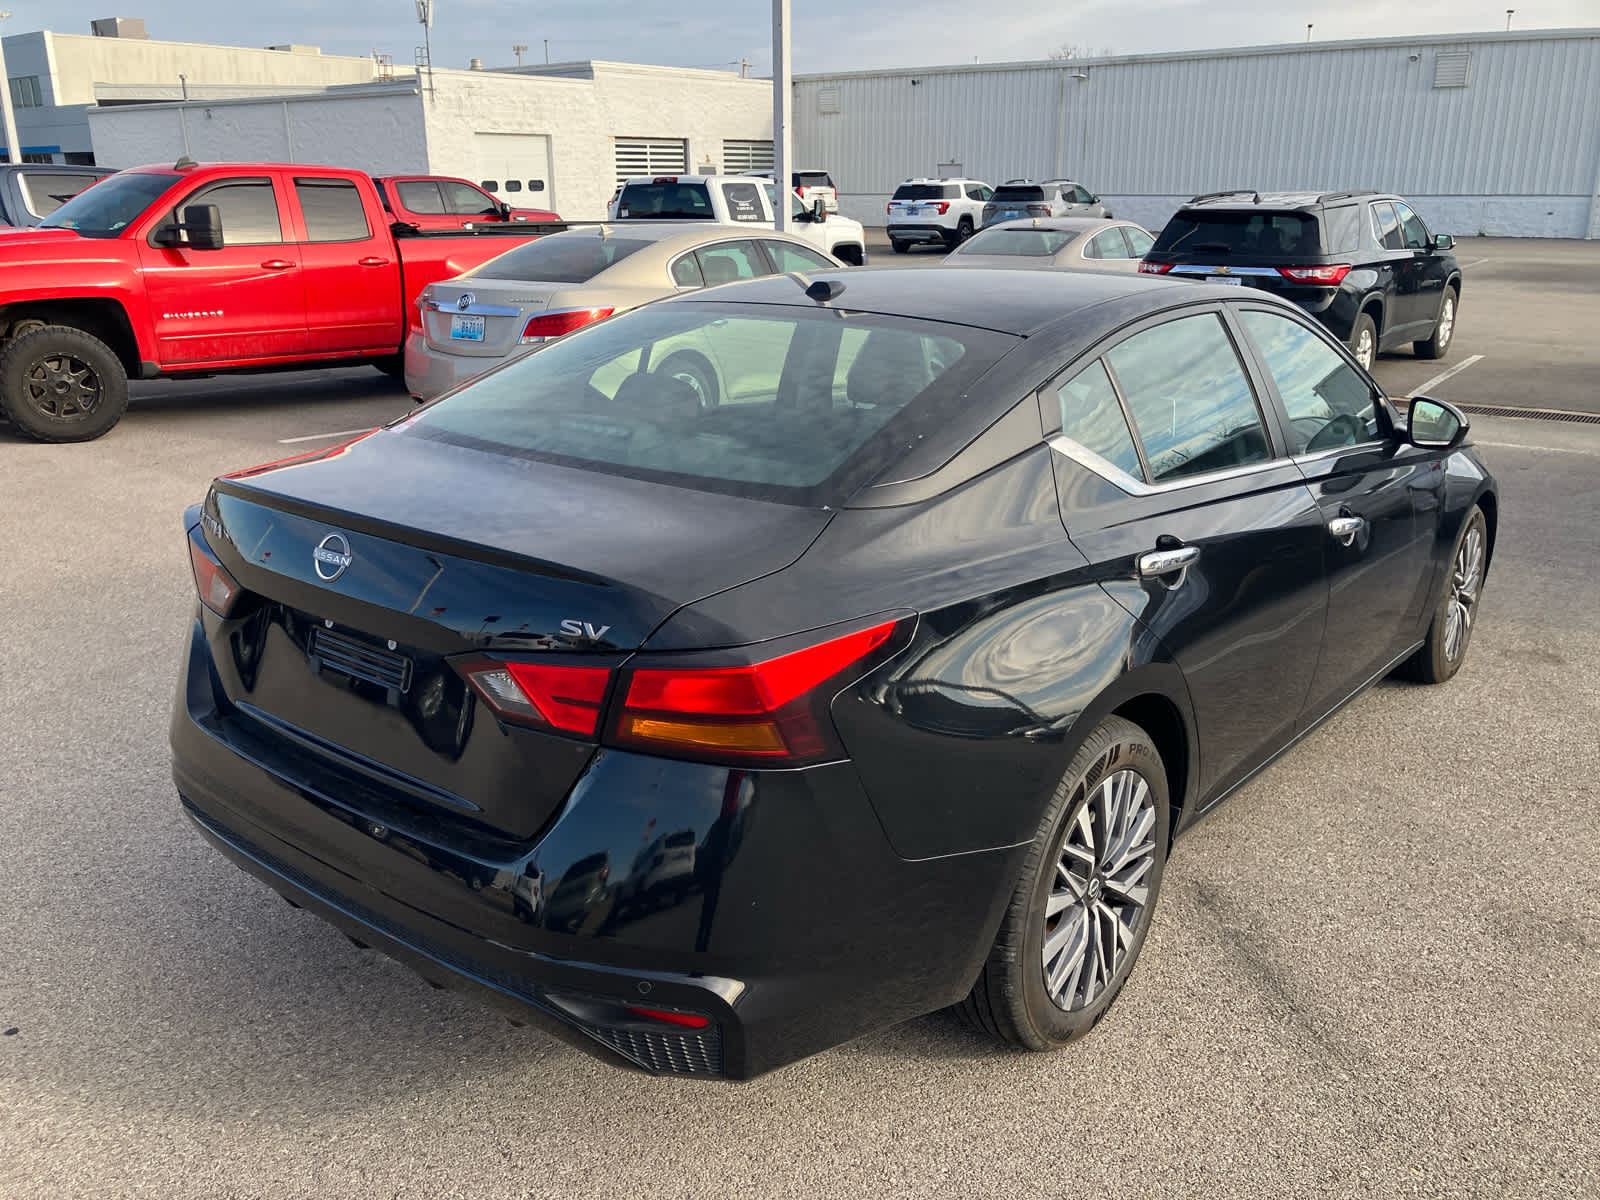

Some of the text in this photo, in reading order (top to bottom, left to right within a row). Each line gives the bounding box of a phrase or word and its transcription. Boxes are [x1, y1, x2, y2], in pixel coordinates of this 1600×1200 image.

[313, 548, 352, 567] ISSAN
[559, 619, 611, 641] SV
[1128, 743, 1150, 757] PRO
